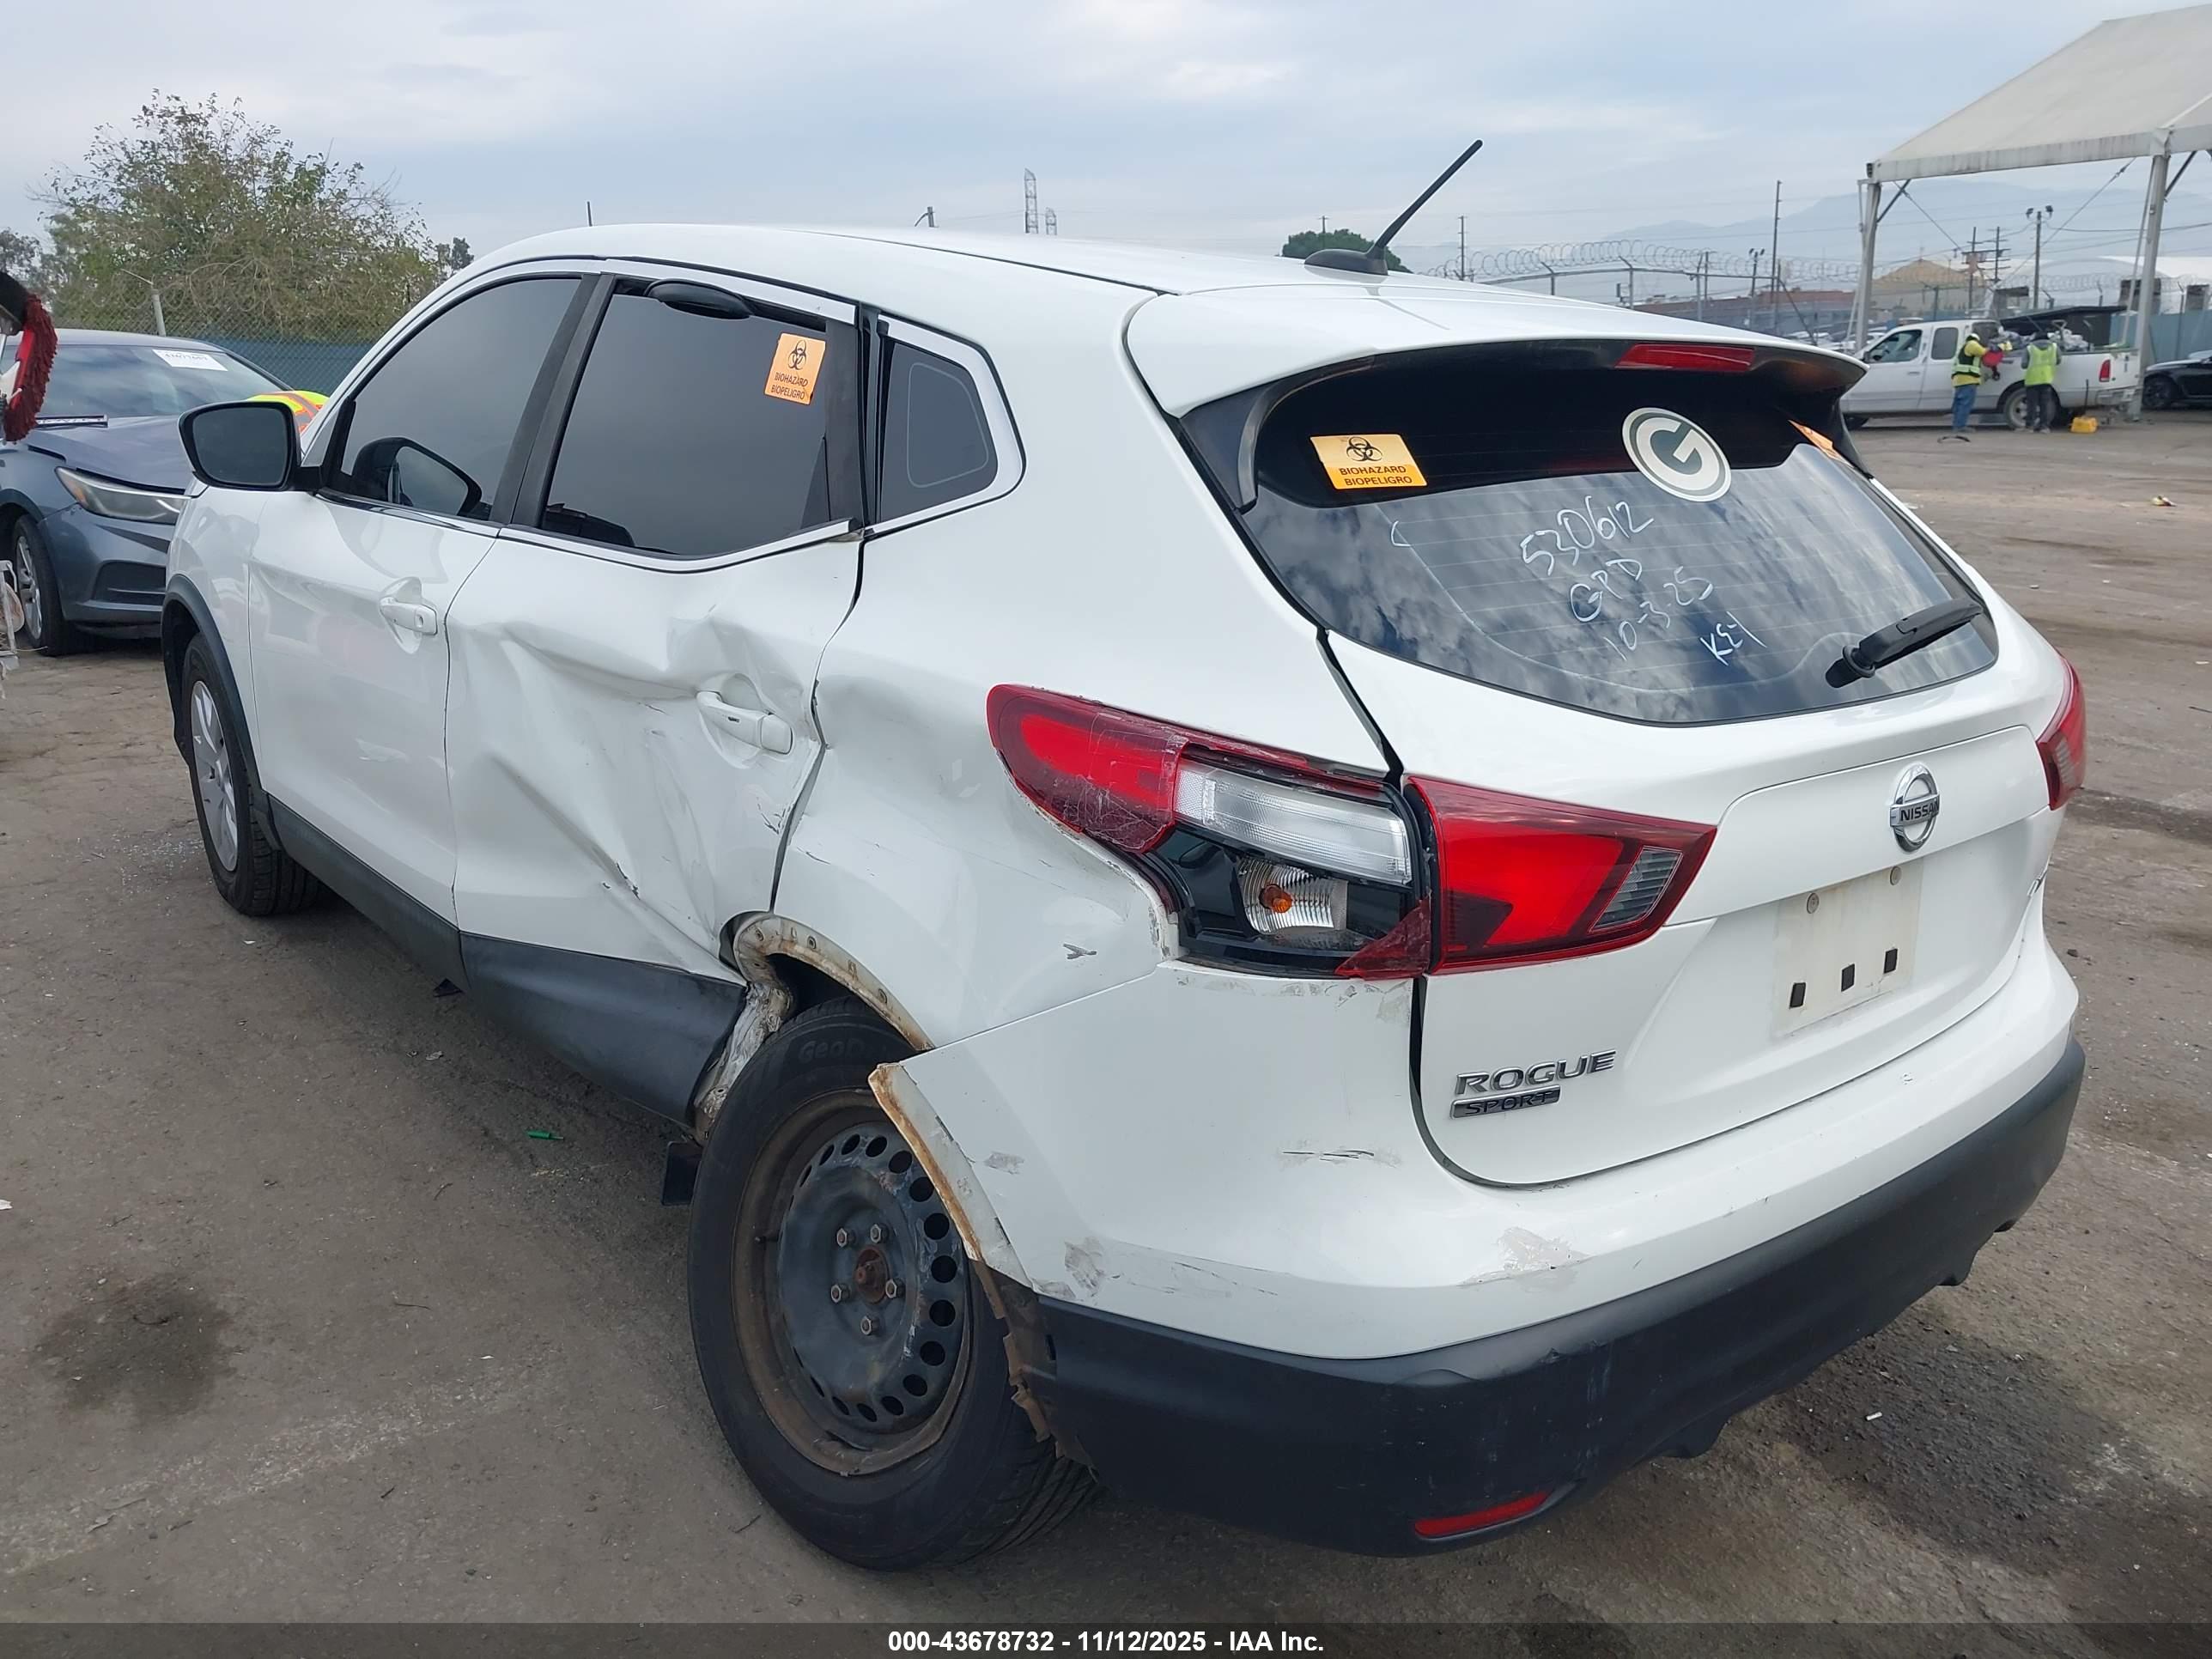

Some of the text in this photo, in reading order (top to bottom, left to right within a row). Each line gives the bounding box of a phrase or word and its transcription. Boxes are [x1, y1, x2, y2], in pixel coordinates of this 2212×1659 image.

[775, 372, 808, 387] BIOHAZARD
[771, 385, 805, 399] BIOPELIGRO
[1636, 416, 1720, 490] G
[1340, 465, 1407, 476] BIOHAZARD
[1345, 474, 1413, 486] BIOPELIGRO
[1901, 801, 1938, 820] NISSAN
[1455, 1049, 1617, 1095] ROGUE
[1465, 1091, 1555, 1115] SPORT
